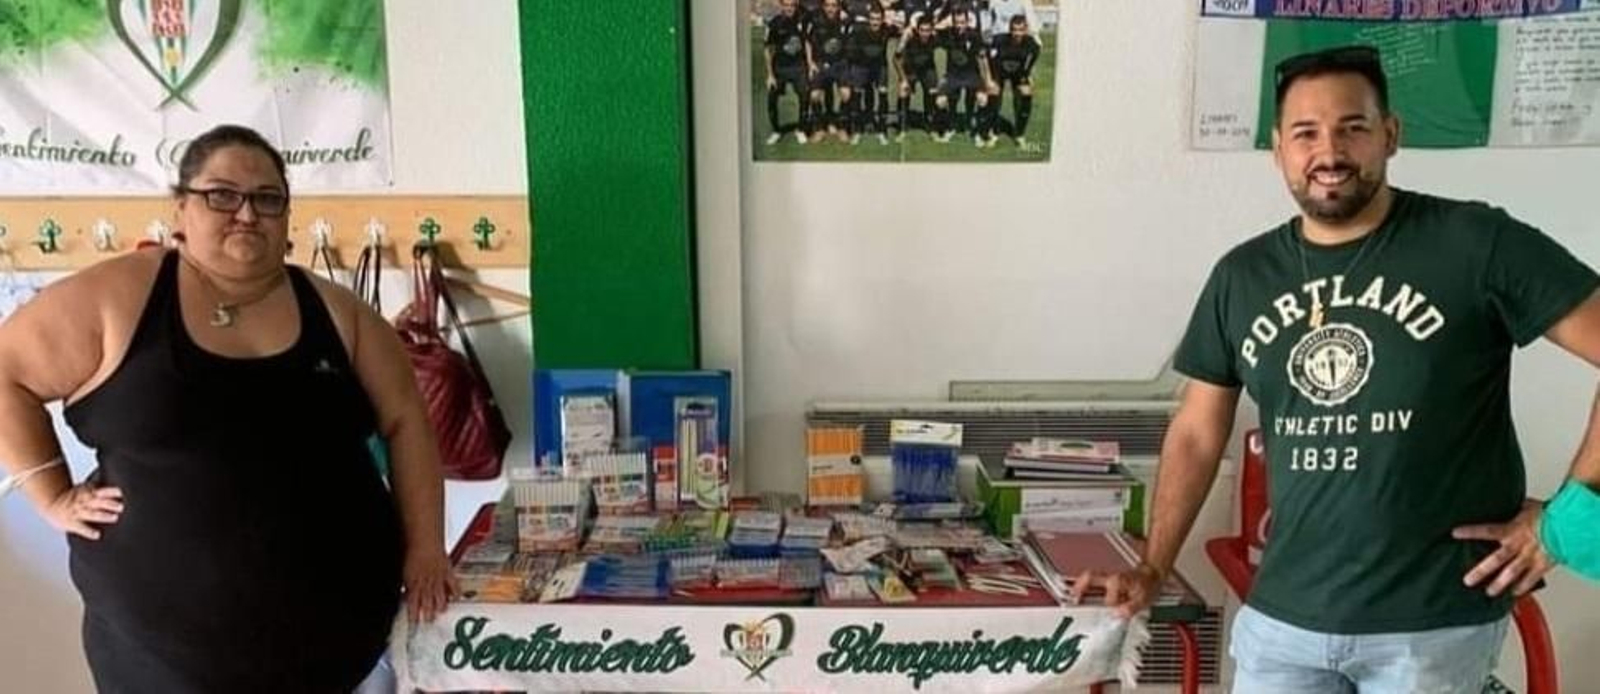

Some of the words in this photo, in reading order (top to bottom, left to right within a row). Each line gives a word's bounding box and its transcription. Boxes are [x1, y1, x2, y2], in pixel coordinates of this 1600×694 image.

[0, 127, 136, 166] entimiento
[1242, 275, 1445, 368] PORTLAND
[1371, 410, 1413, 433] DIV
[1290, 447, 1359, 471] 1832
[444, 616, 695, 673] Sentimiento
[816, 616, 1088, 690] Blanquiverde
